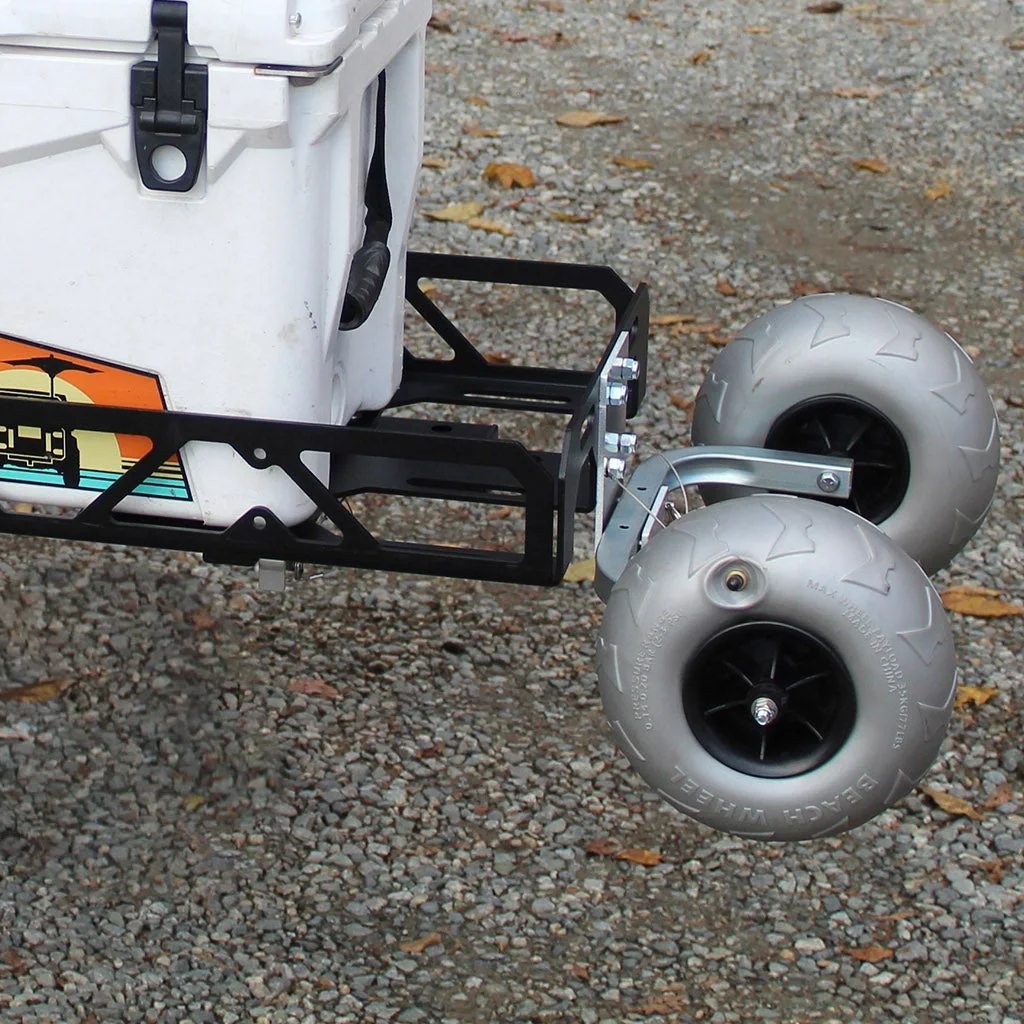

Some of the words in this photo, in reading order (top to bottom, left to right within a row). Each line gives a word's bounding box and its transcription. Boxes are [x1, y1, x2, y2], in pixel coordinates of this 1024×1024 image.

[879, 655, 899, 693] CHINA
[669, 764, 769, 827] WHEEL
[782, 772, 880, 826] BEACH
